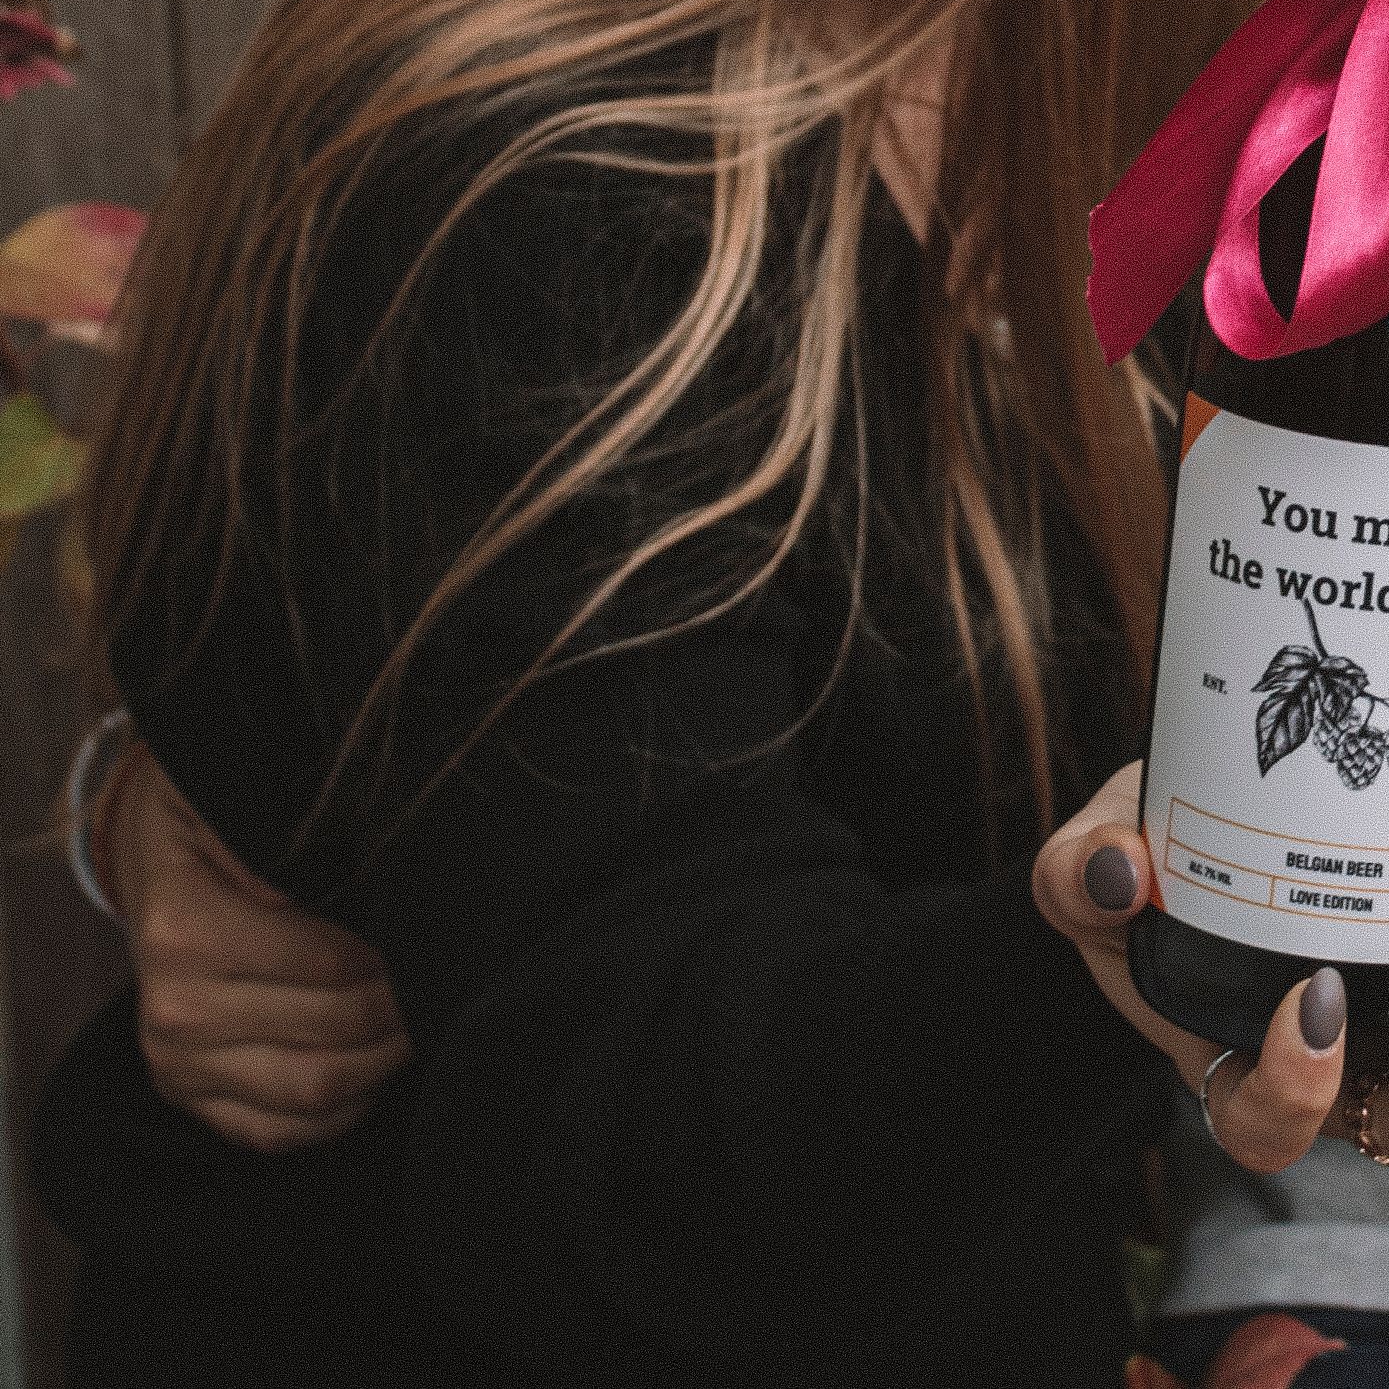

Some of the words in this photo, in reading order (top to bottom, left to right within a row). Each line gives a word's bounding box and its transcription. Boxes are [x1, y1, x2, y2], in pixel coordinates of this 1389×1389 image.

[1258, 485, 1338, 539] You
[1209, 539, 1263, 589] the
[1286, 851, 1343, 873] BELGIAN
[1346, 860, 1383, 878] BEER
[1289, 888, 1321, 907] LOVE
[1323, 894, 1373, 912] EDITION
